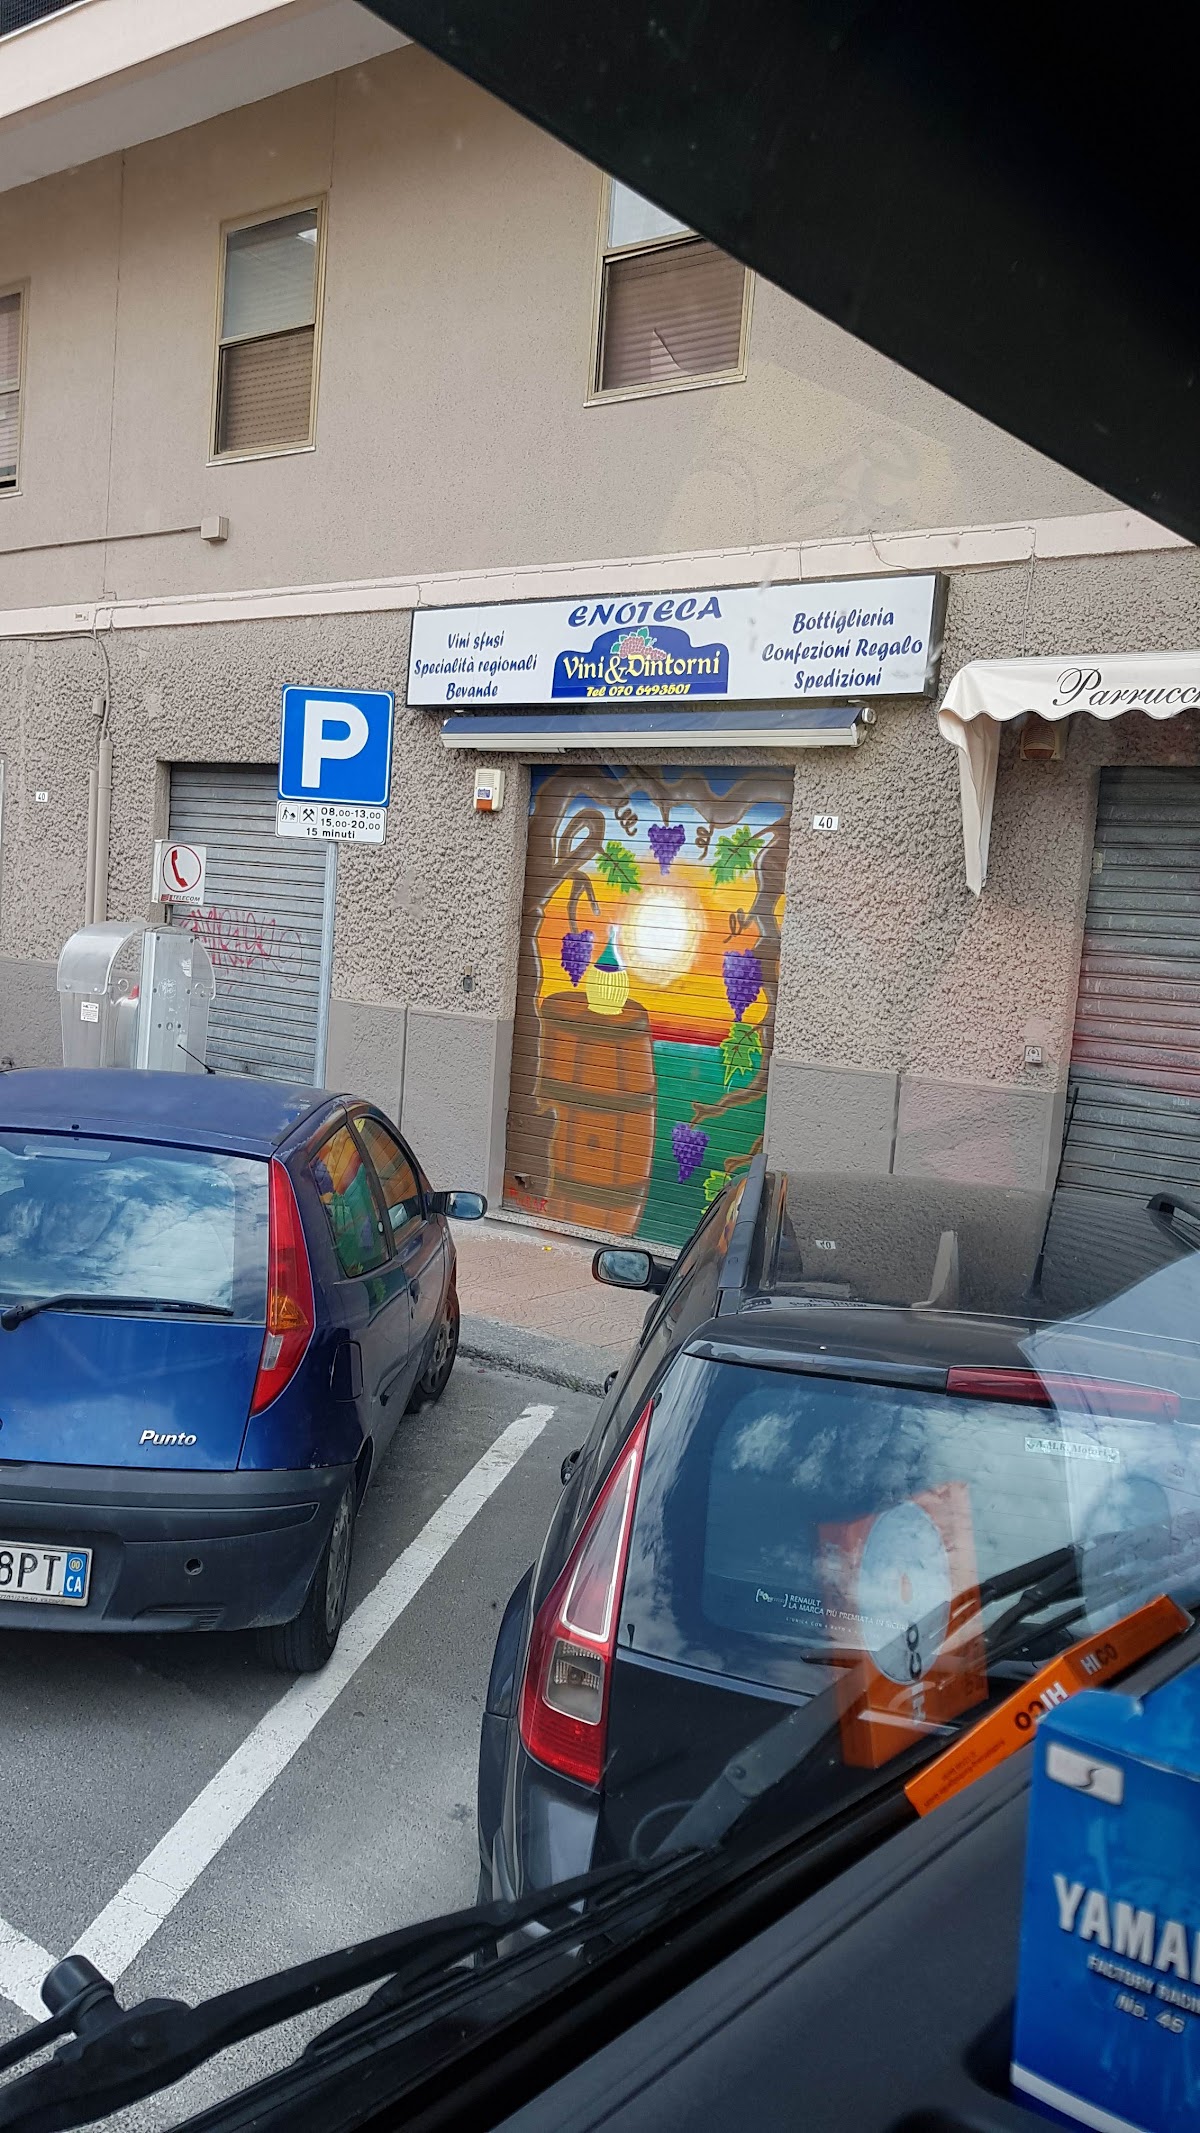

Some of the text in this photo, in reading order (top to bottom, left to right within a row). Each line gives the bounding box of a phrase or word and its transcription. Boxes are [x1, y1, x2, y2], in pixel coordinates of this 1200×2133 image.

[568, 597, 722, 627] ENOTECA
[793, 607, 894, 634] Bottiglieria
[448, 631, 504, 651] Vini sfusi
[762, 635, 923, 663] Confezioni Regalo
[414, 654, 538, 678] Specialità regionali
[446, 681, 498, 700] Bevande
[586, 683, 691, 697] Tel 070 6493501
[794, 667, 882, 693] Spedizioni
[301, 700, 369, 788] P
[306, 827, 355, 839] 15 minuti
[818, 817, 833, 829] 40
[138, 1429, 197, 1447] Punto
[0, 1551, 61, 1591] 8PT
[66, 1576, 82, 1593] CA
[789, 1594, 821, 1606] RENAULT
[788, 1602, 797, 1610] LA
[799, 1604, 824, 1615] MARCA
[839, 1611, 874, 1624] PREMIATA
[1080, 1643, 1118, 1675] HICO
